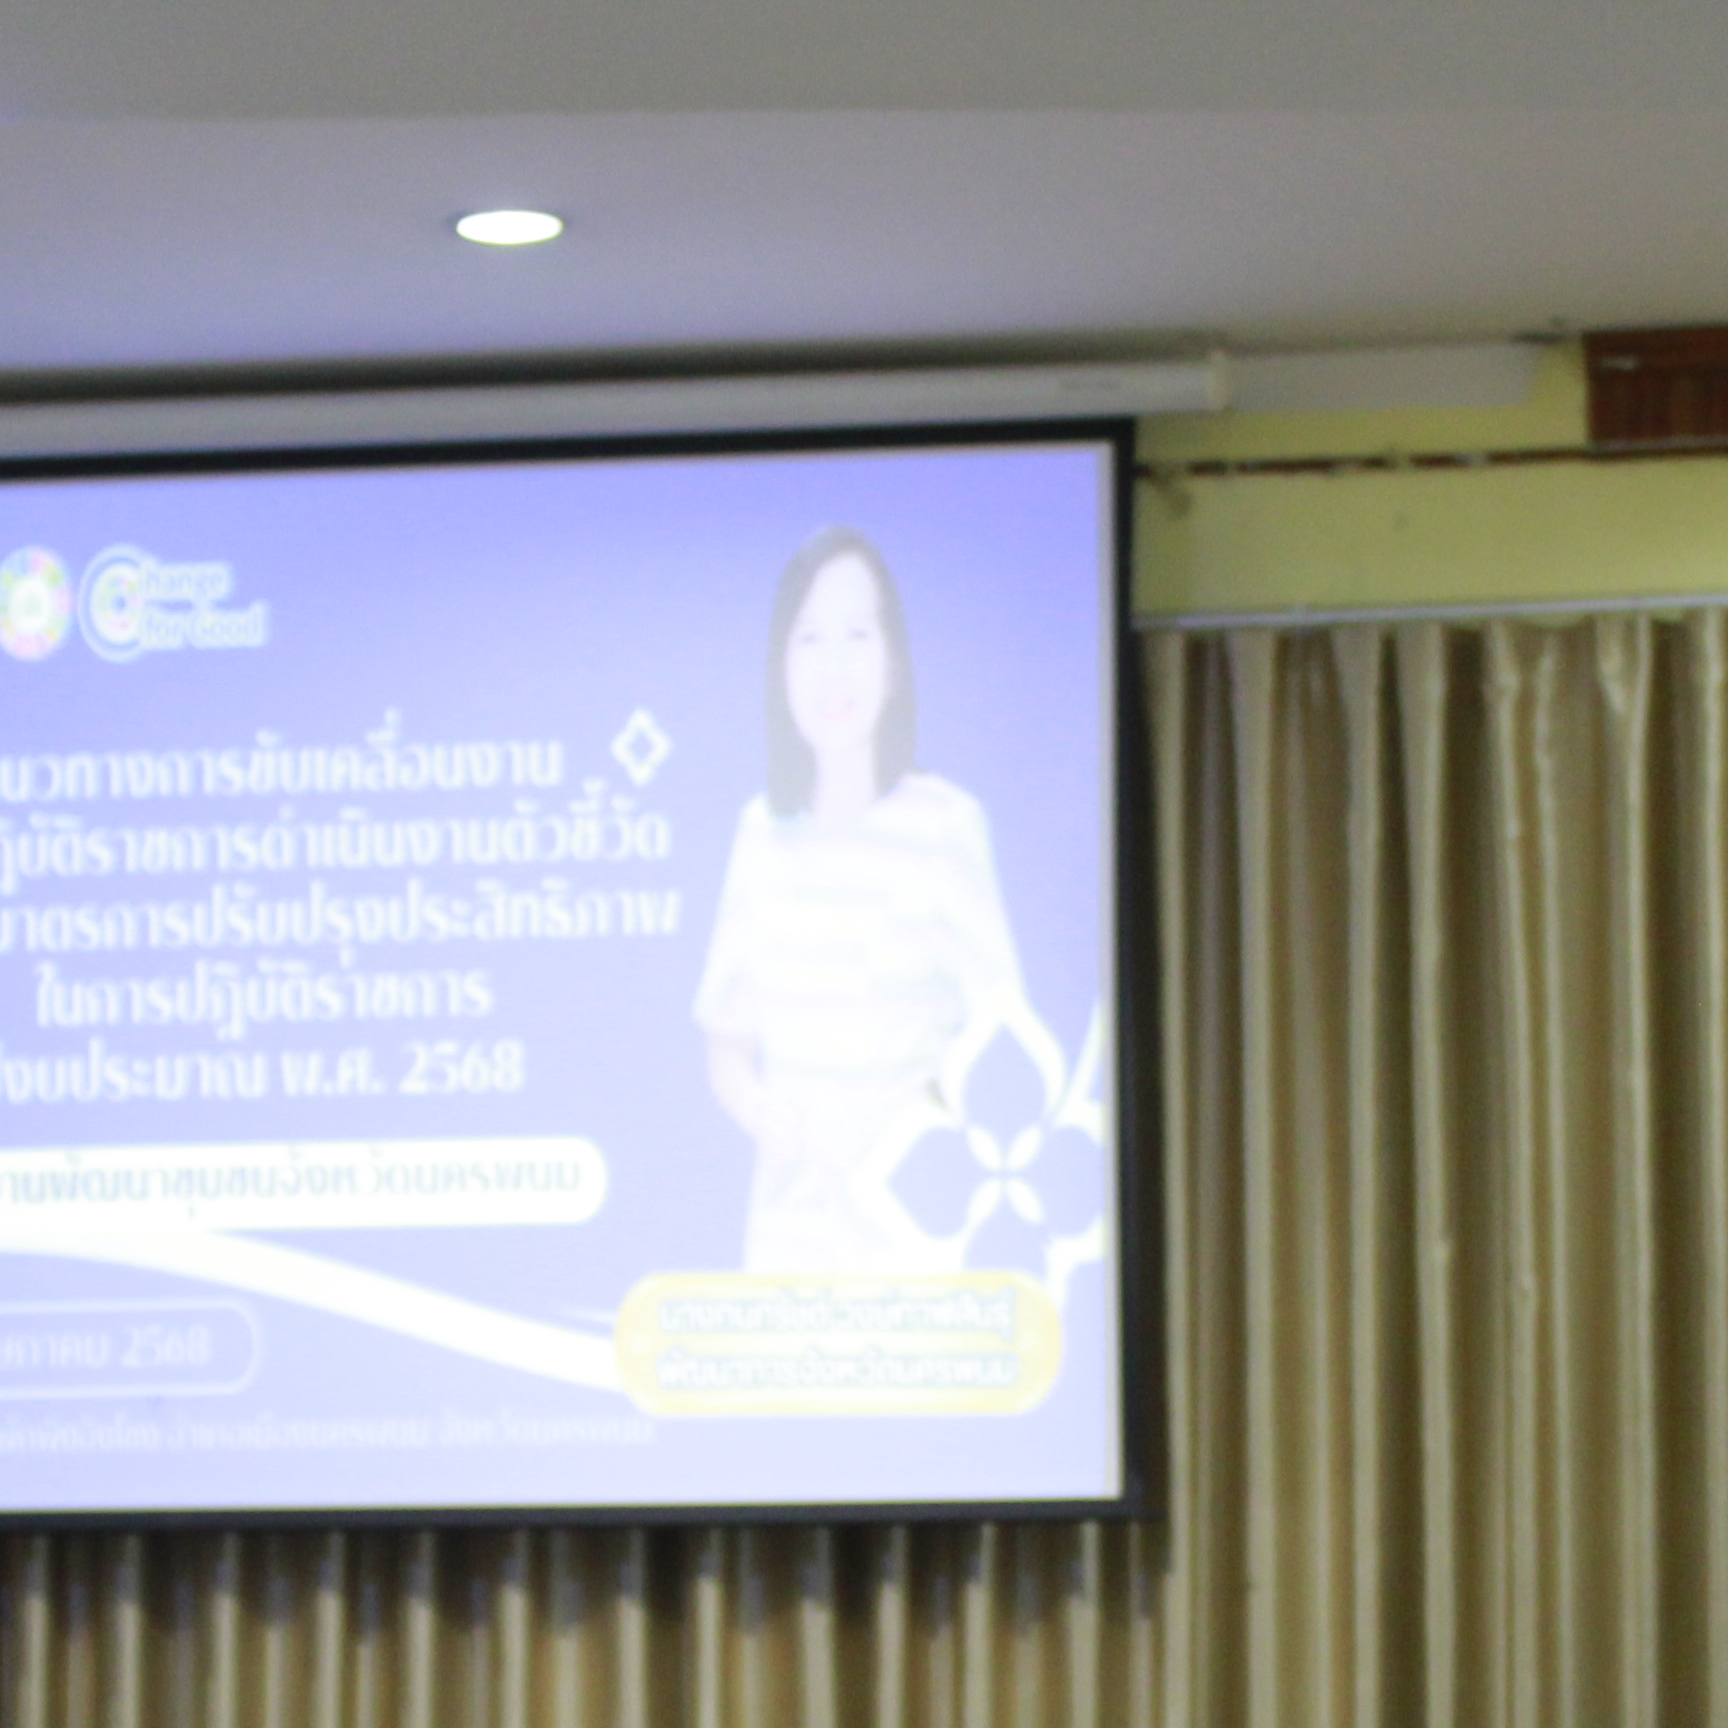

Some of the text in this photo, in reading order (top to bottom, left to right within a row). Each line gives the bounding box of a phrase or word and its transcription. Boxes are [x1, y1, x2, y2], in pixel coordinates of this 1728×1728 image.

[34, 956, 493, 1041] ในการปฏิบัติราชการ
[280, 1047, 384, 1096] พ.ศ.
[398, 1039, 527, 1095] 2568
[120, 1325, 212, 1369] 2568
